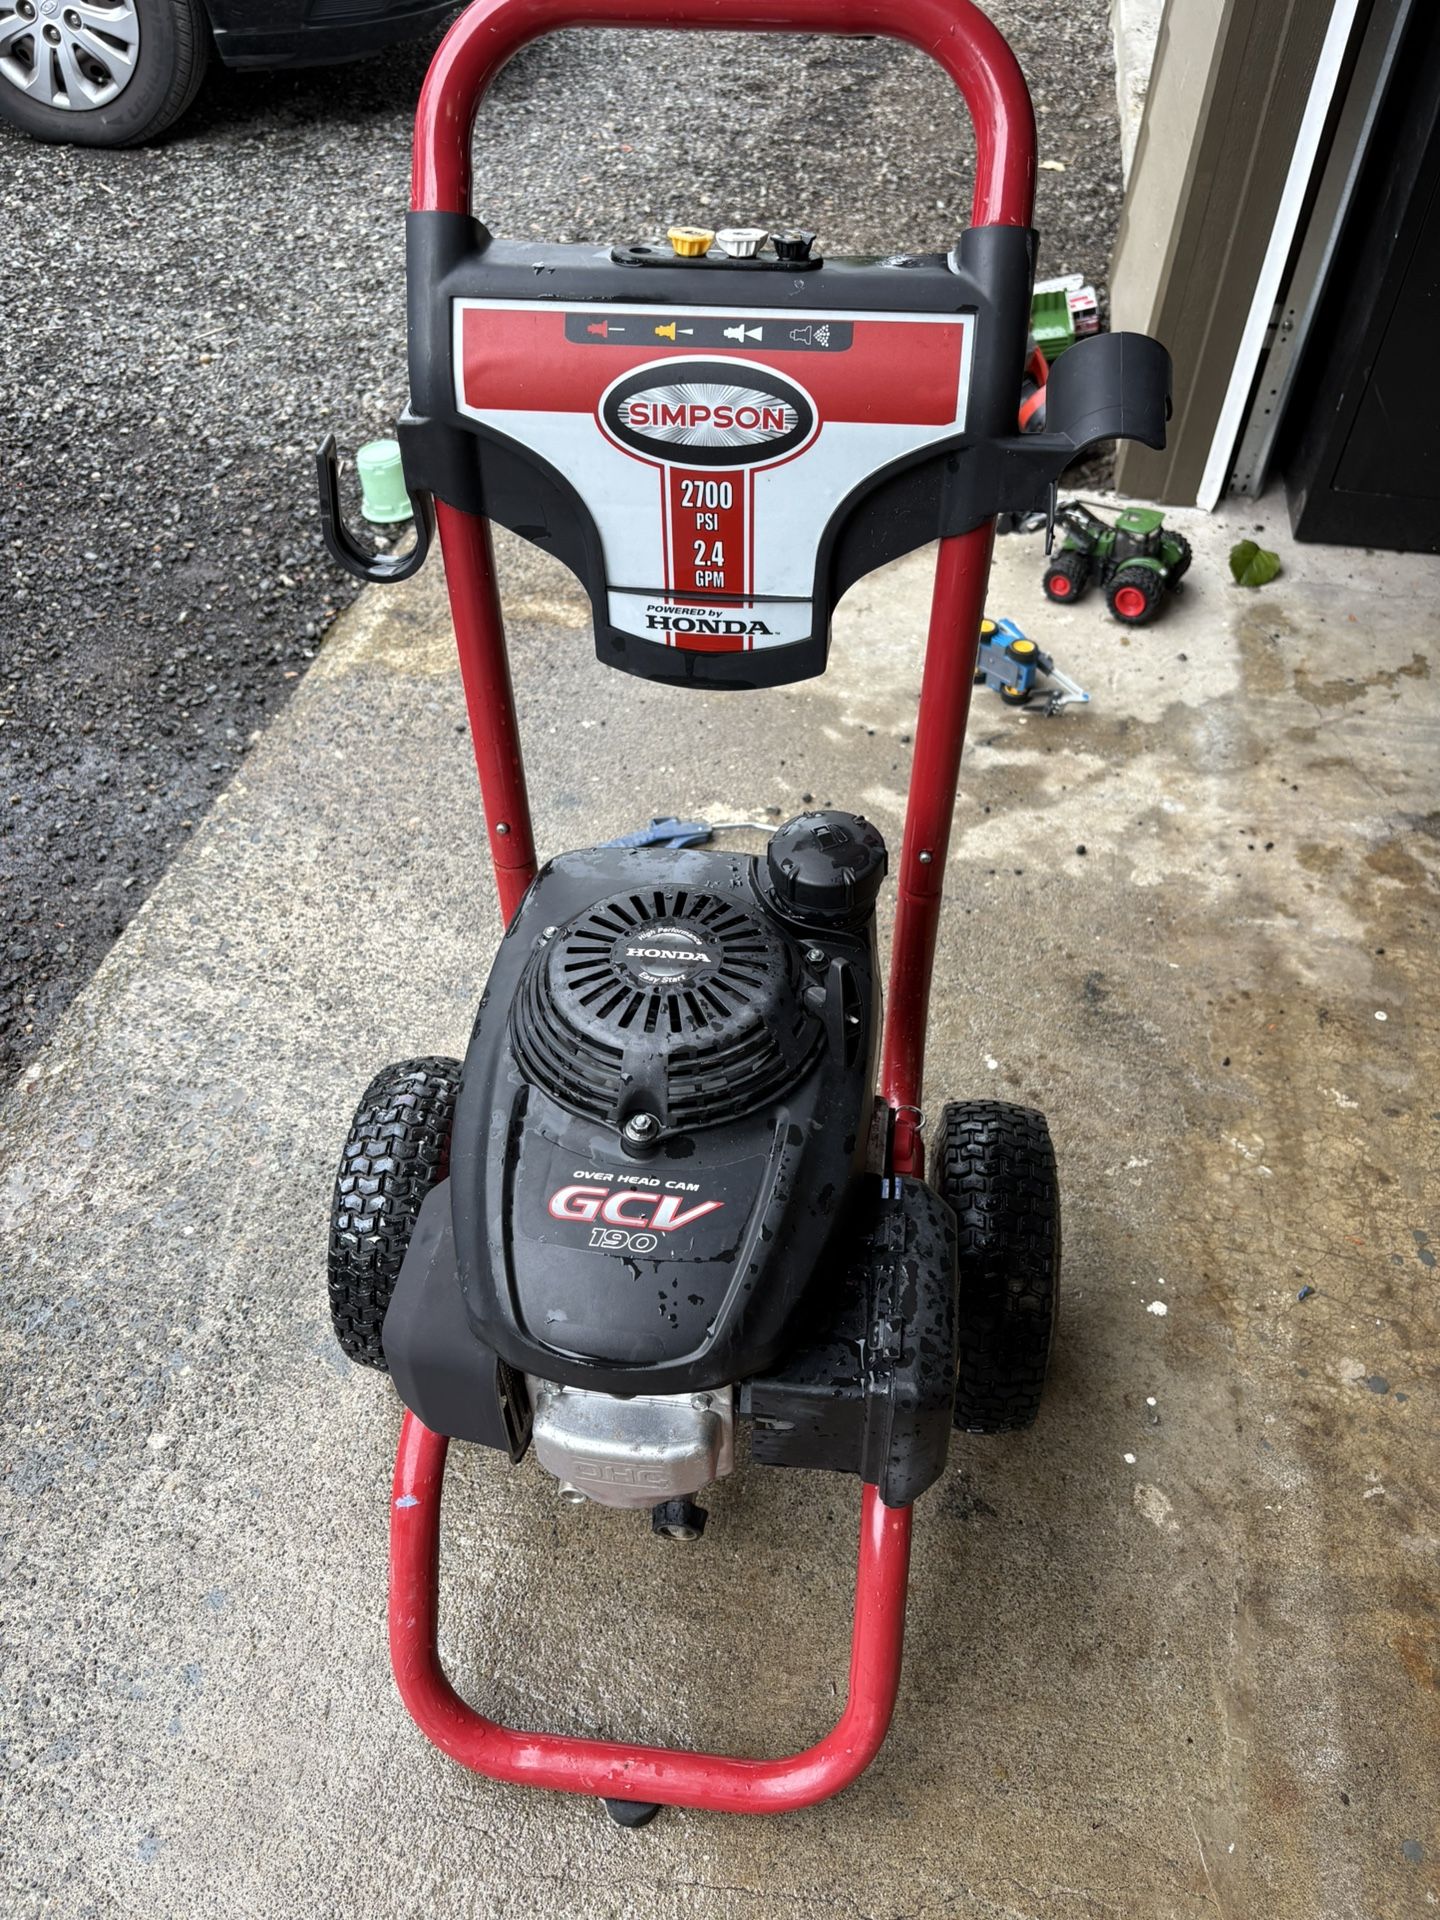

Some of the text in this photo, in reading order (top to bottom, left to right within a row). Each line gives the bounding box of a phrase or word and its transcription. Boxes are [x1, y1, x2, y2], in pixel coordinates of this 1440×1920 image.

[629, 403, 784, 430] SIMPSON
[681, 480, 733, 509] 2700
[696, 513, 719, 531] PSI
[693, 540, 725, 567] 2.4
[695, 570, 725, 588] GPM
[647, 604, 723, 619] POWERED by
[646, 615, 773, 635] HONDA
[638, 930, 656, 941] High
[626, 948, 712, 962] HONDA
[638, 971, 687, 983] Easy Start
[573, 1170, 700, 1192] OVER HEAD CAM
[548, 1184, 725, 1232] GCV
[589, 1228, 658, 1253] 190
